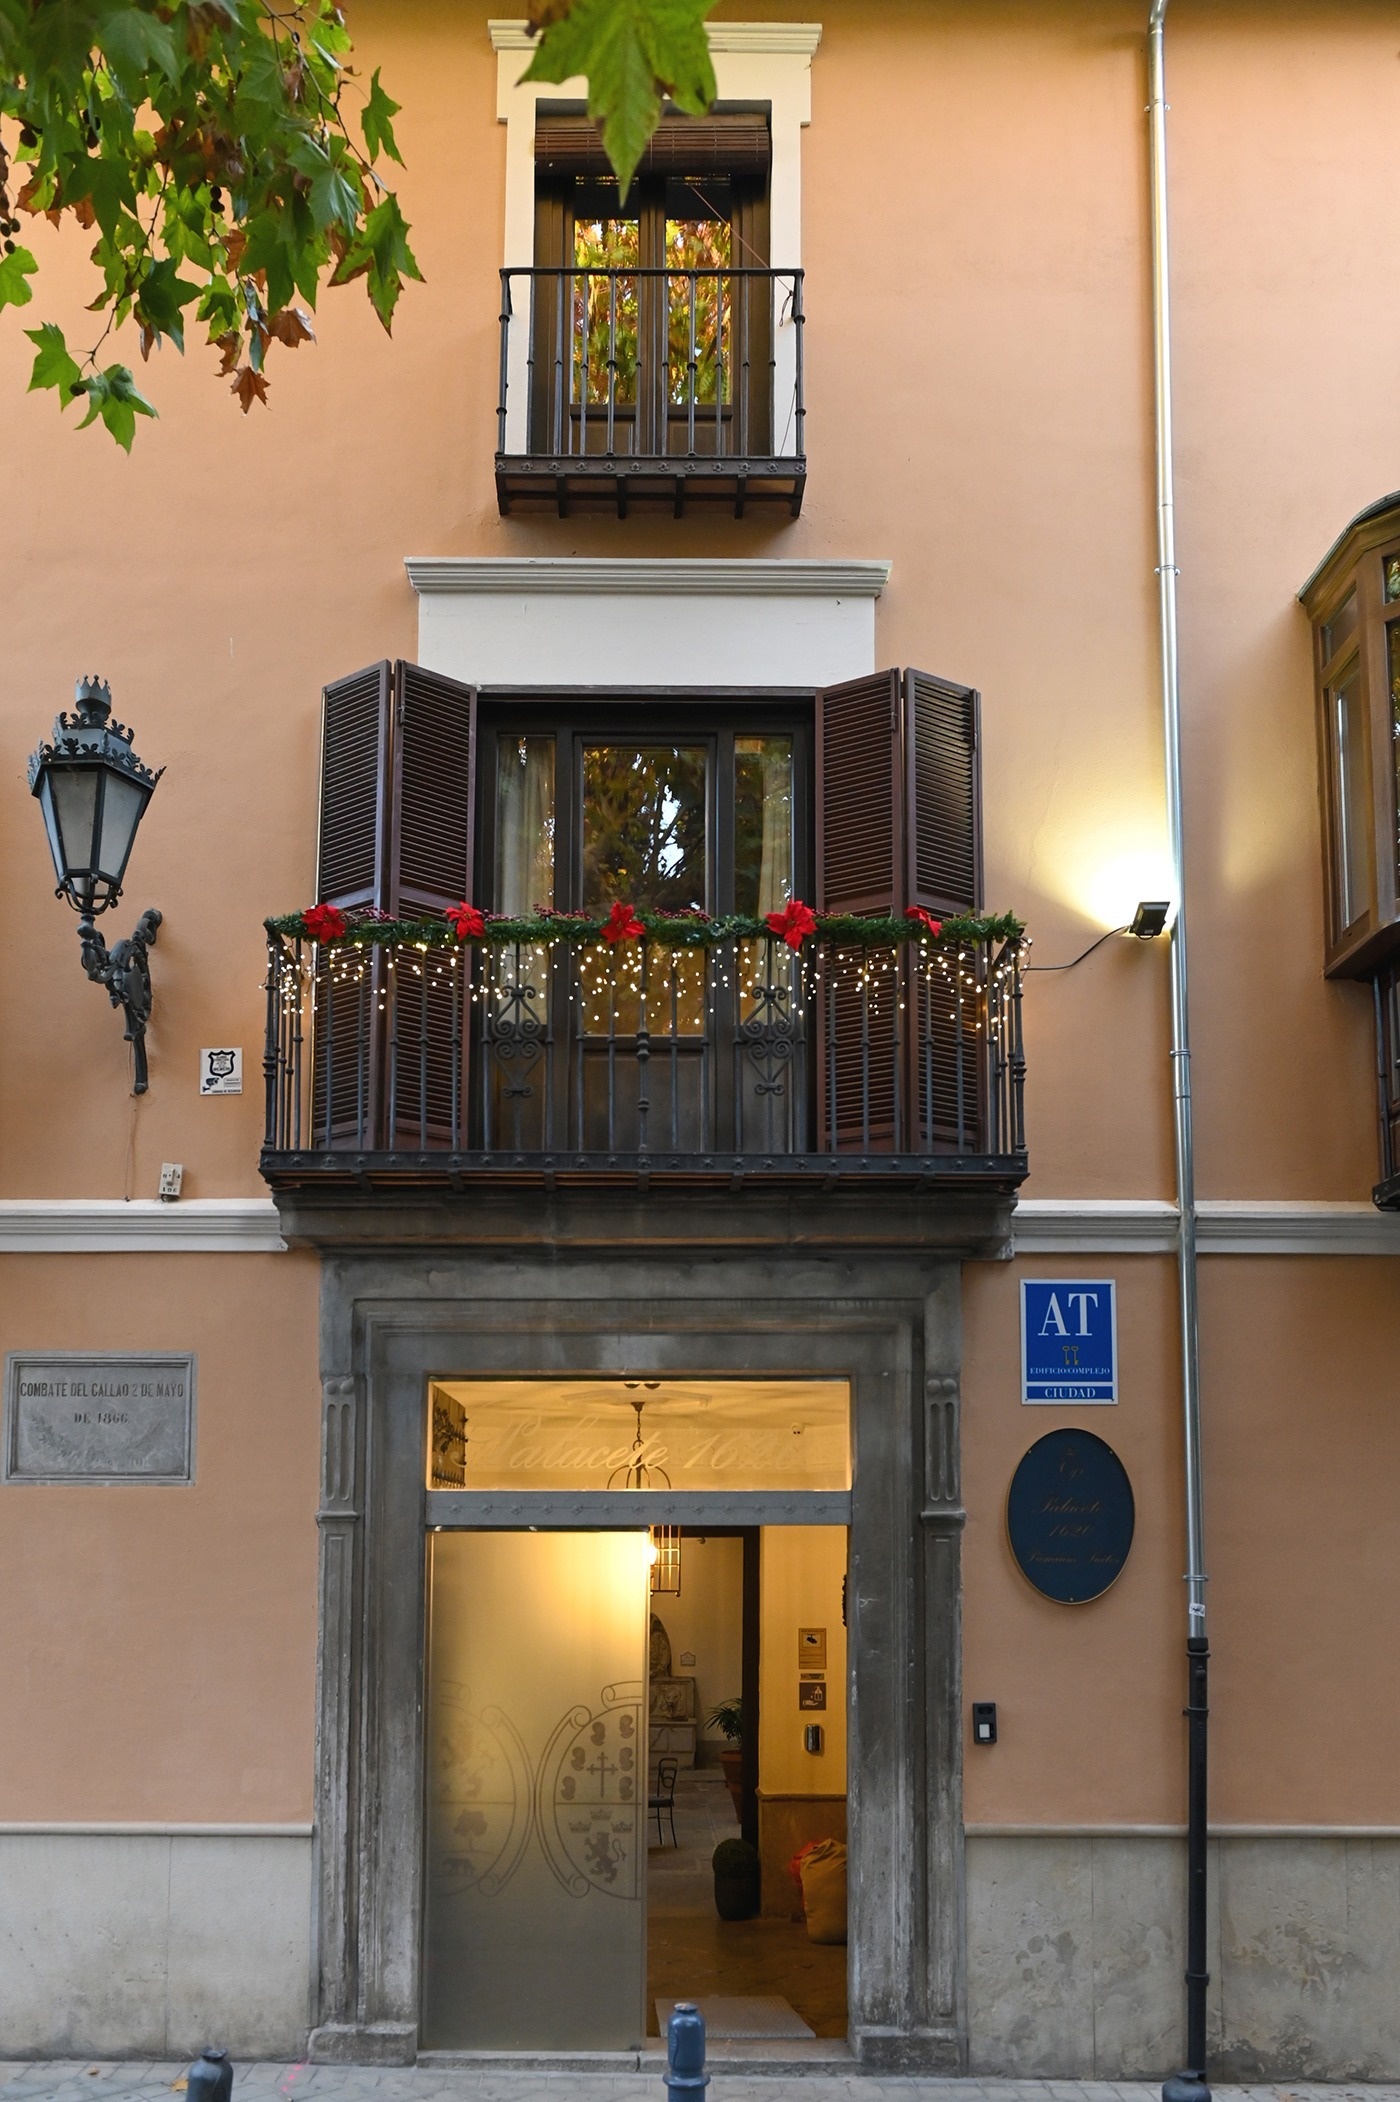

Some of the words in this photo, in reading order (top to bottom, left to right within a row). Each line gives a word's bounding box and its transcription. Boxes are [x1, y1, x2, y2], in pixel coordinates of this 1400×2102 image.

[1037, 1292, 1099, 1336] AT
[20, 1382, 68, 1397] COMBATE
[71, 1382, 88, 1397] DEL
[91, 1382, 129, 1397] CALLAO
[131, 1382, 140, 1397] 2
[141, 1382, 154, 1397] DE
[155, 1382, 184, 1398] MAYO
[1044, 1387, 1096, 1399] CIUDAD
[73, 1412, 91, 1425] DE
[96, 1412, 129, 1425] 1866
[452, 1402, 669, 1470] Palacete
